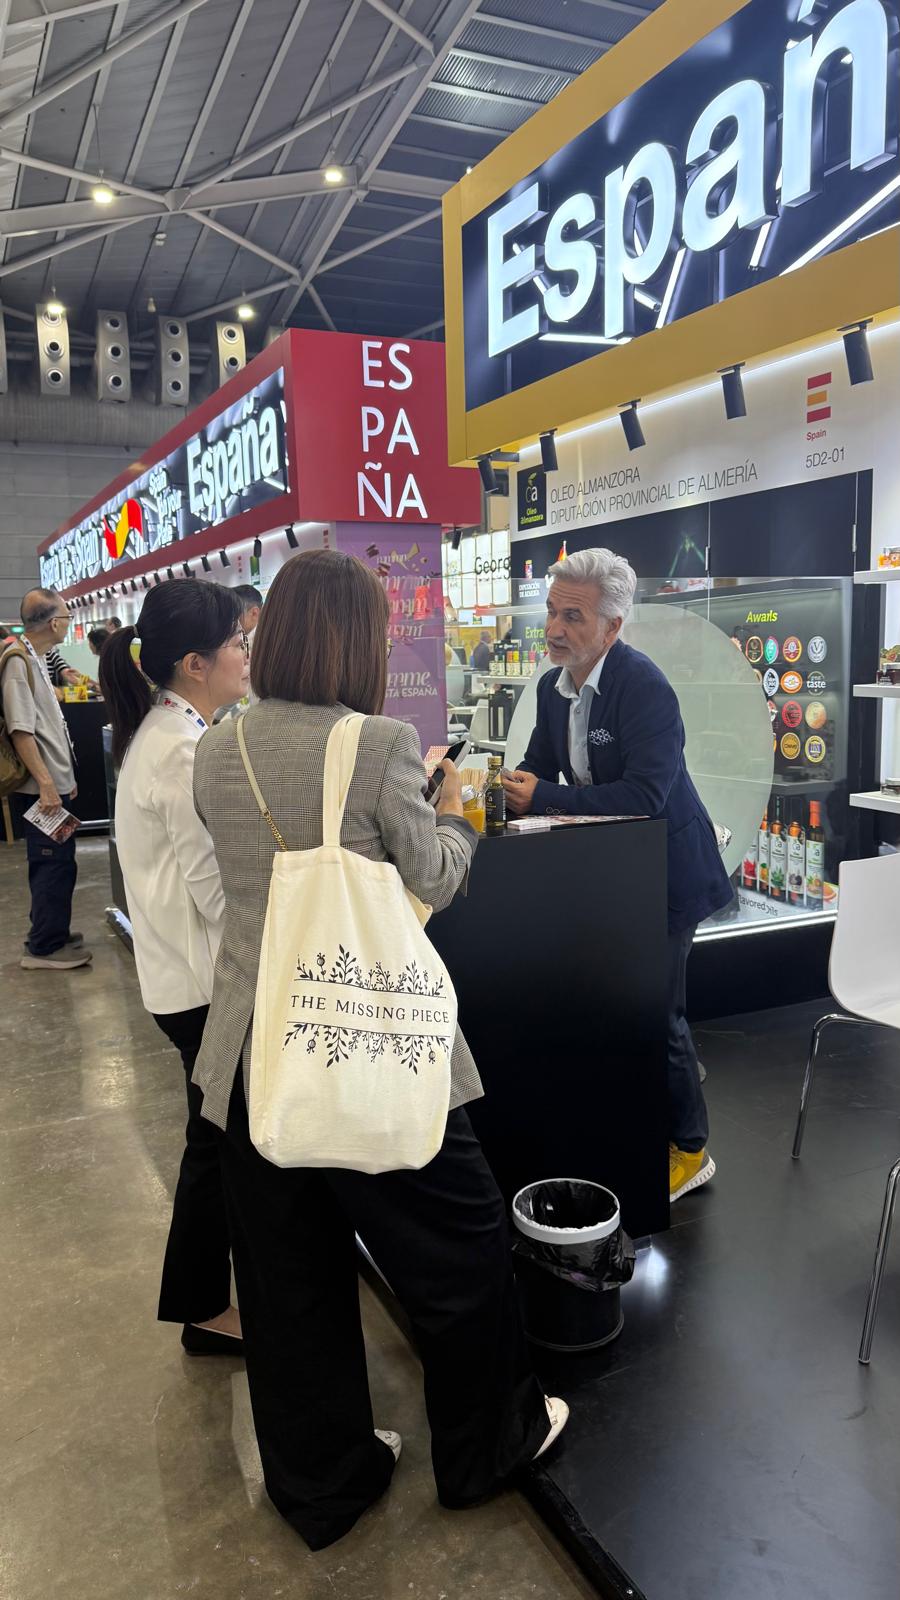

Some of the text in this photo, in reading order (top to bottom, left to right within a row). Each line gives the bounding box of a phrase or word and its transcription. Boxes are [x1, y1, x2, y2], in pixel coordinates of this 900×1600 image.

[362, 340, 413, 391] ES
[361, 406, 420, 456] PA
[806, 429, 827, 441] Spain
[187, 397, 279, 522] España
[806, 447, 845, 468] 5D2-01
[357, 462, 429, 519] ÑA
[551, 467, 641, 504] OLEO ALMANZORA
[551, 459, 758, 525] DIPUTACIÓN PROVINCIAL DE ALMERÍA
[474, 556, 511, 580] Georg
[525, 627, 544, 639] Extra
[401, 685, 438, 698] ESPAÑA
[806, 680, 827, 689] taste
[290, 995, 450, 1024] THE MISSING PIECE
